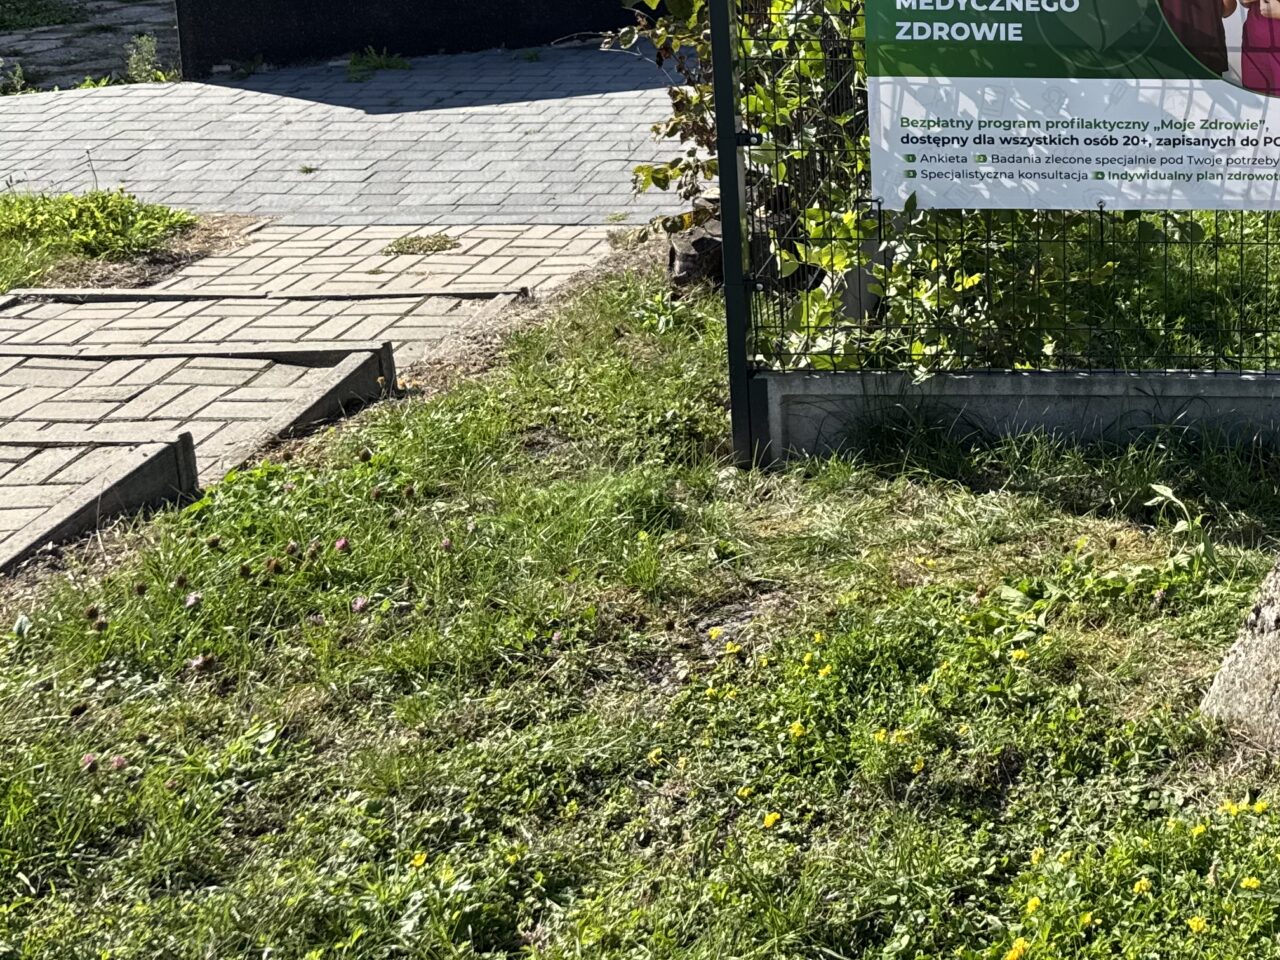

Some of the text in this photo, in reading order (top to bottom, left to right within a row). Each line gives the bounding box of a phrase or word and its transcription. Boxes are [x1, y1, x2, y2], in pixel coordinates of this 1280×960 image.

[895, 22, 1023, 42] ZDROWIE
[900, 116, 975, 132] Bezpłatny
[978, 119, 1042, 133] program
[1045, 116, 1150, 134] profilaktyczny
[900, 133, 969, 148] dostępny
[972, 133, 995, 146] dla
[998, 133, 1080, 149] wszystkich
[1083, 134, 1119, 147] osób
[1122, 134, 1153, 149] 20+,
[1155, 135, 1237, 151] zapisanych
[1240, 135, 1260, 148] do
[920, 154, 968, 164] Ankieta
[991, 154, 1041, 164] Badania
[1044, 155, 1092, 165] zlecone
[1095, 154, 1156, 168] specjalnie
[1159, 154, 1184, 168] pod
[1186, 154, 1223, 168] Twoje
[1225, 155, 1280, 169] potrzeby
[920, 170, 1014, 181] Specjalistyczna
[1018, 170, 1088, 181] konsultacja
[1108, 170, 1193, 184] Indywidualny
[1196, 170, 1224, 184] plan
